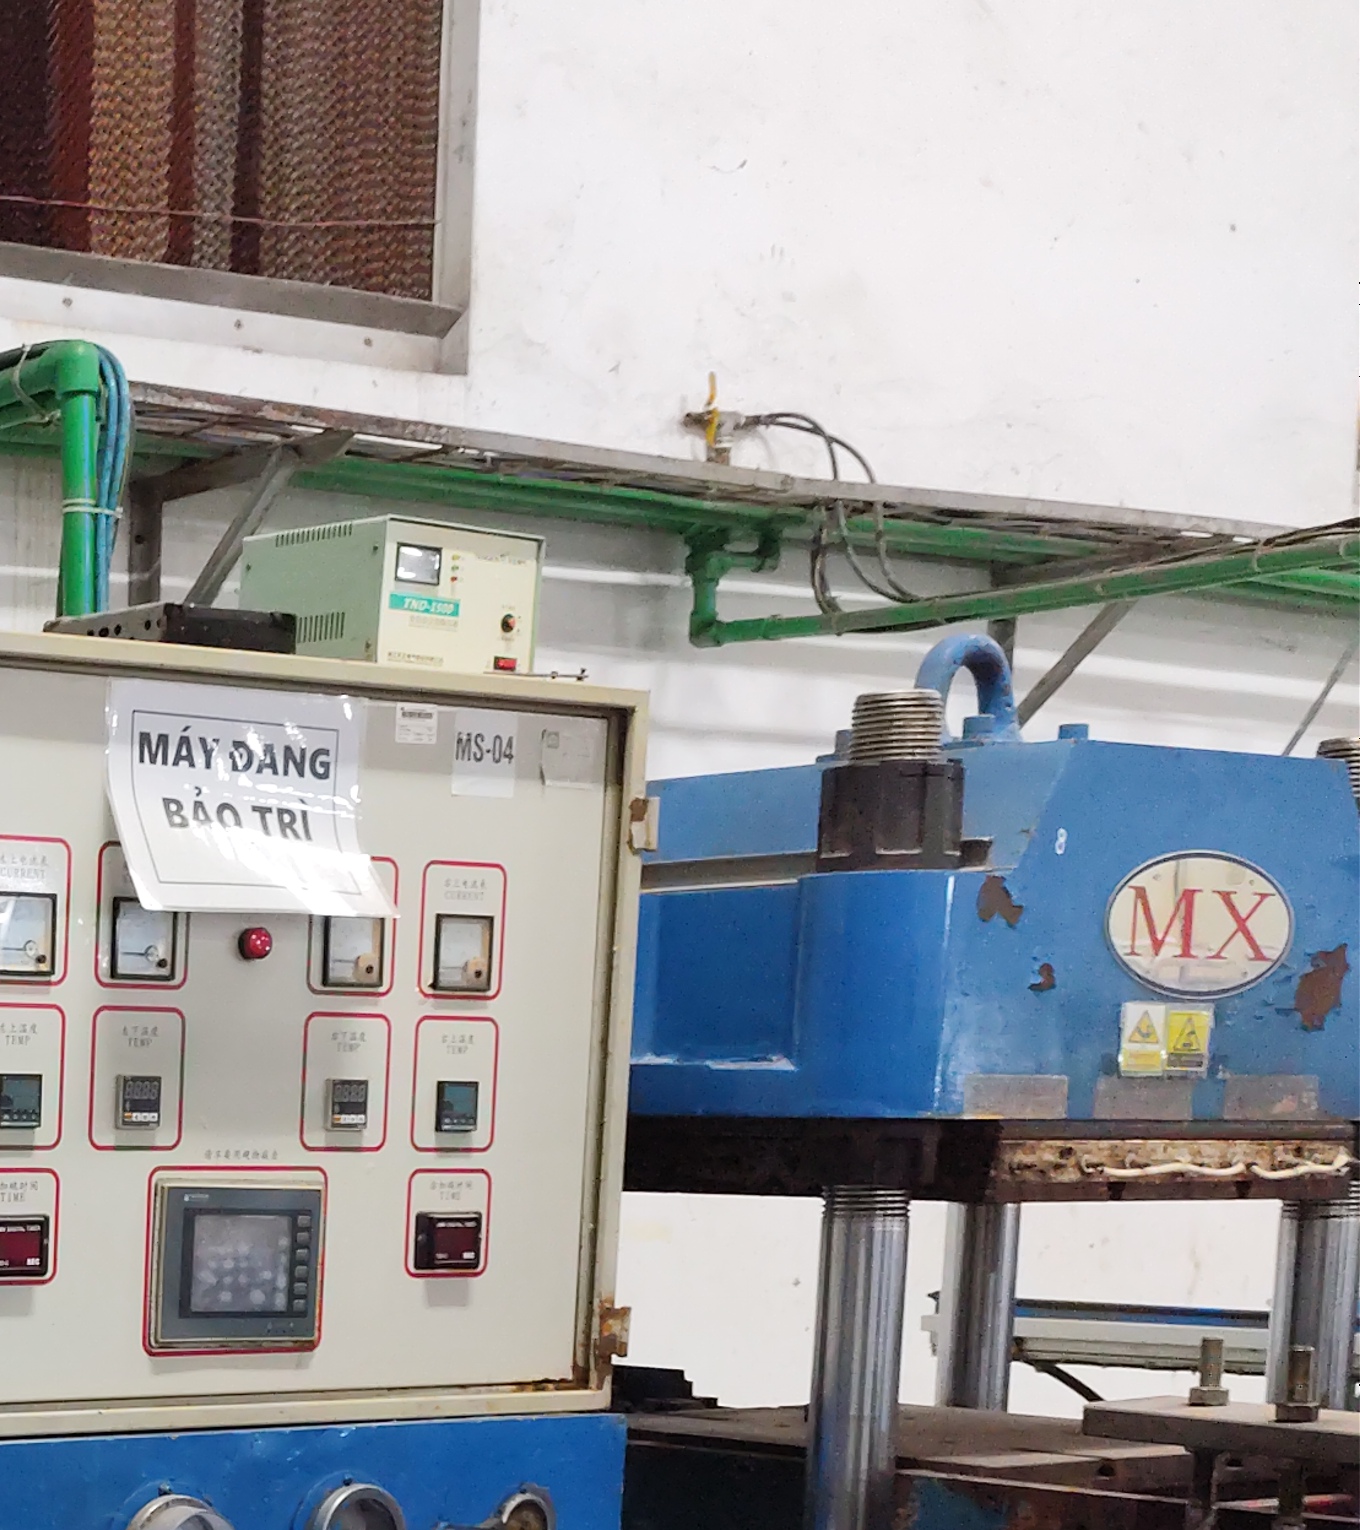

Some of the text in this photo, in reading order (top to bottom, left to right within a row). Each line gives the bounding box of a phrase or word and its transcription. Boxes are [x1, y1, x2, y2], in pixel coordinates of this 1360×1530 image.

[139, 725, 330, 780] MÁY ĐANG
[454, 731, 514, 764] MS-04
[162, 786, 313, 842] BẢO TRÌ
[0, 867, 46, 879] CURRENT
[1126, 885, 1277, 962] MX
[5, 1034, 32, 1046] TEMP
[128, 1037, 153, 1049] TEMP
[336, 1042, 361, 1053] TEMP
[446, 1045, 469, 1056] TEMP
[0, 1192, 26, 1203] TIME
